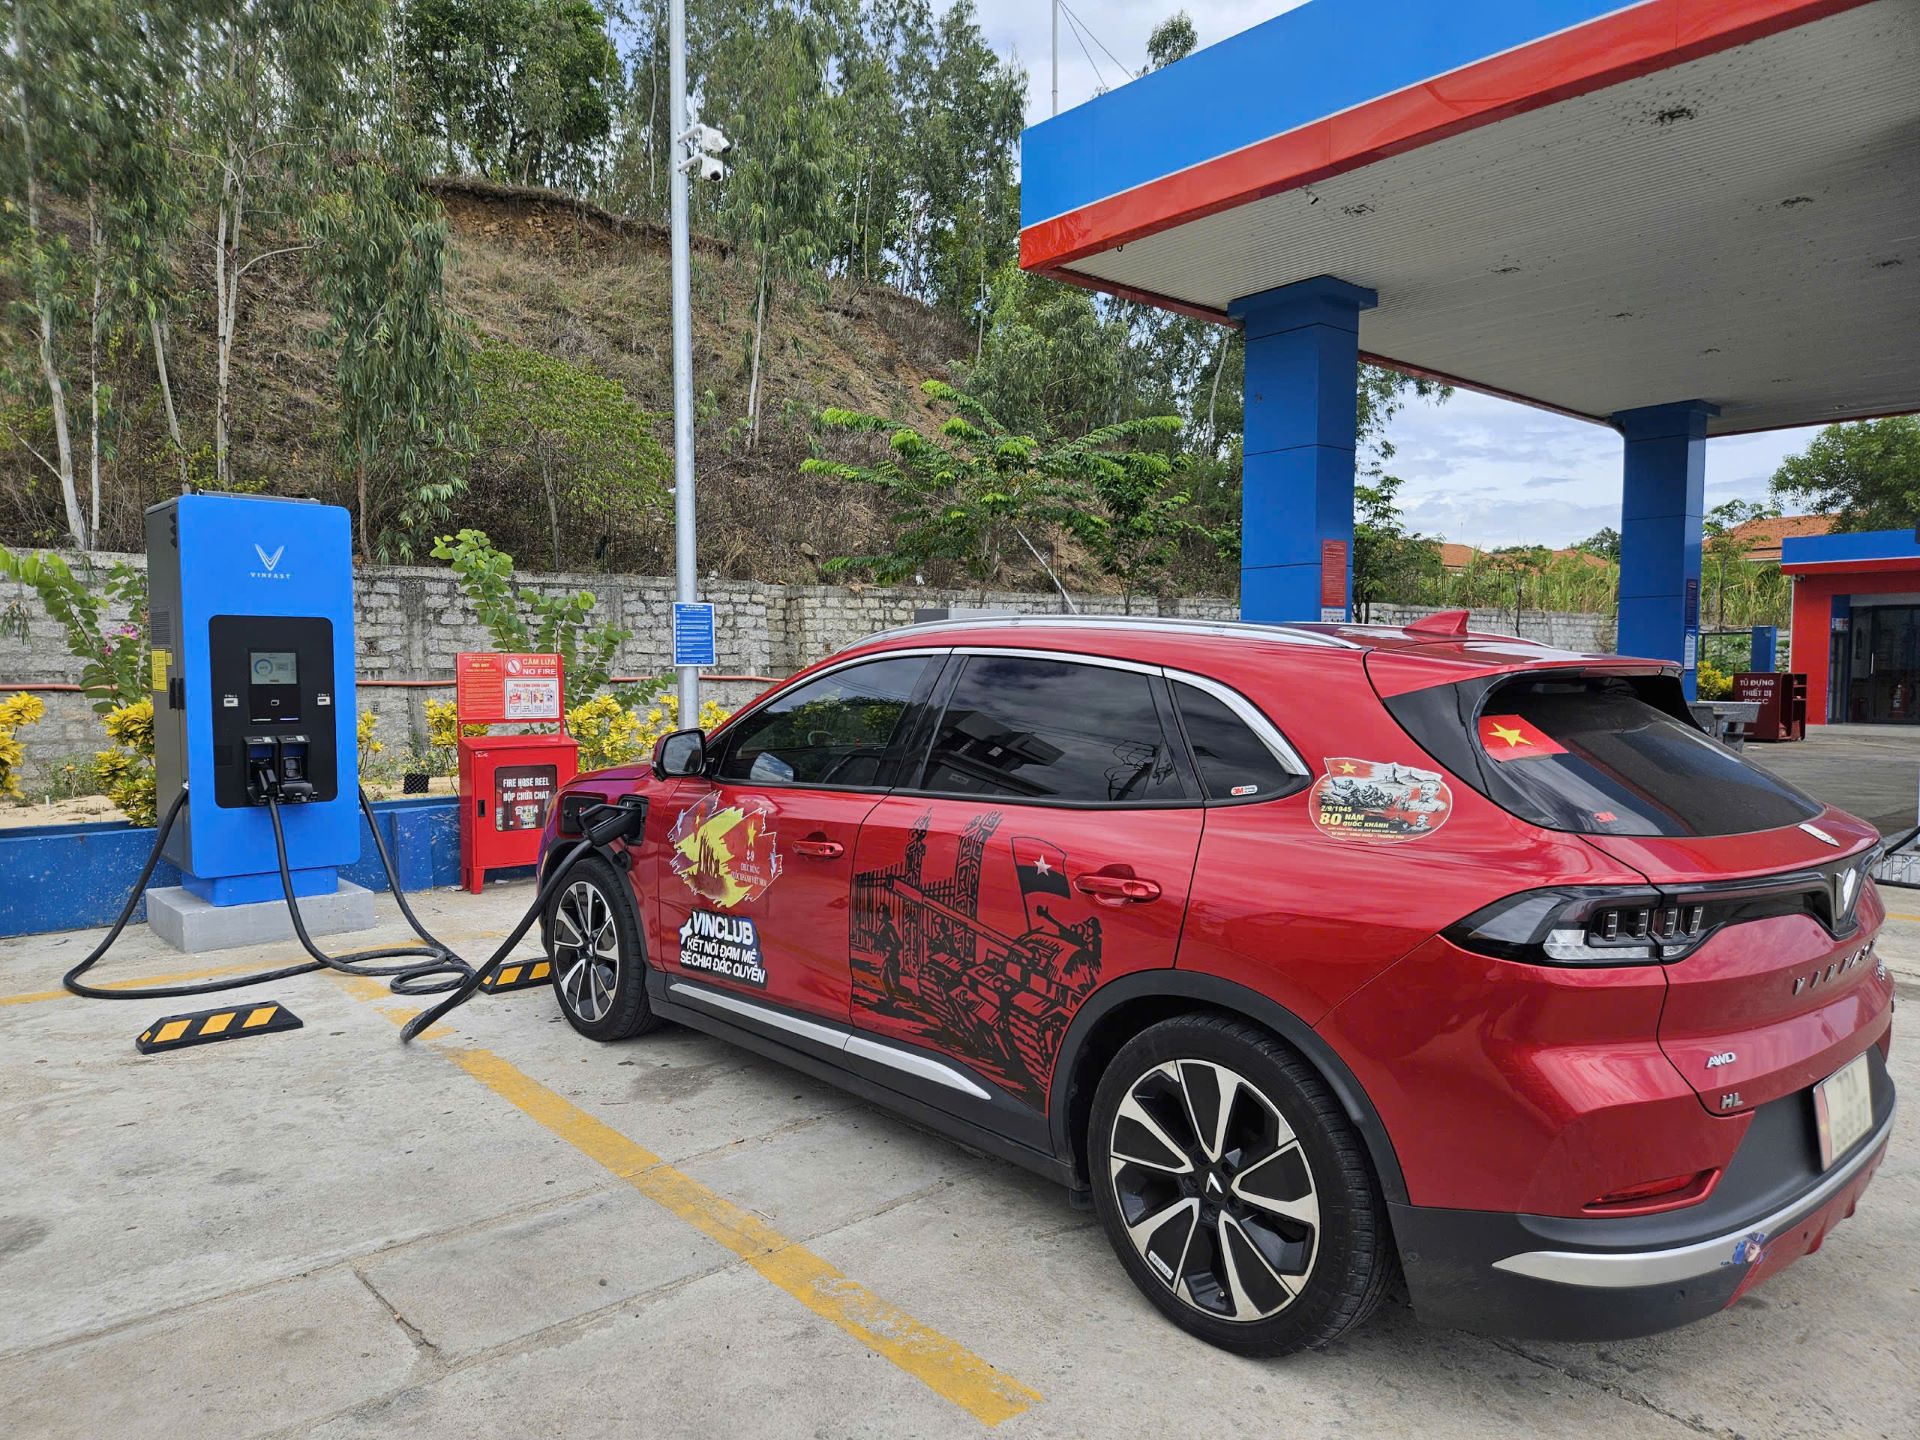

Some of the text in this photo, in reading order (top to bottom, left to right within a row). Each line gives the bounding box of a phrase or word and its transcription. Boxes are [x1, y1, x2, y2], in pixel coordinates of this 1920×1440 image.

[503, 777, 550, 788] FIRE HOSE REEL
[503, 790, 516, 803] HỘP
[1232, 787, 1244, 796] 3M
[1320, 805, 1352, 813] 2/9/1945
[1319, 812, 1343, 826] 80
[1342, 819, 1389, 829] QUỐC KHÁNH
[692, 911, 754, 946] VINCLUB
[686, 935, 705, 952] KẾT
[704, 939, 719, 956] NỐI
[720, 945, 741, 961] ĐAM
[691, 952, 712, 970] CHIA
[732, 961, 766, 984] QUYỀN
[1705, 1051, 1737, 1069] AWD
[1720, 1091, 1744, 1110] HL
